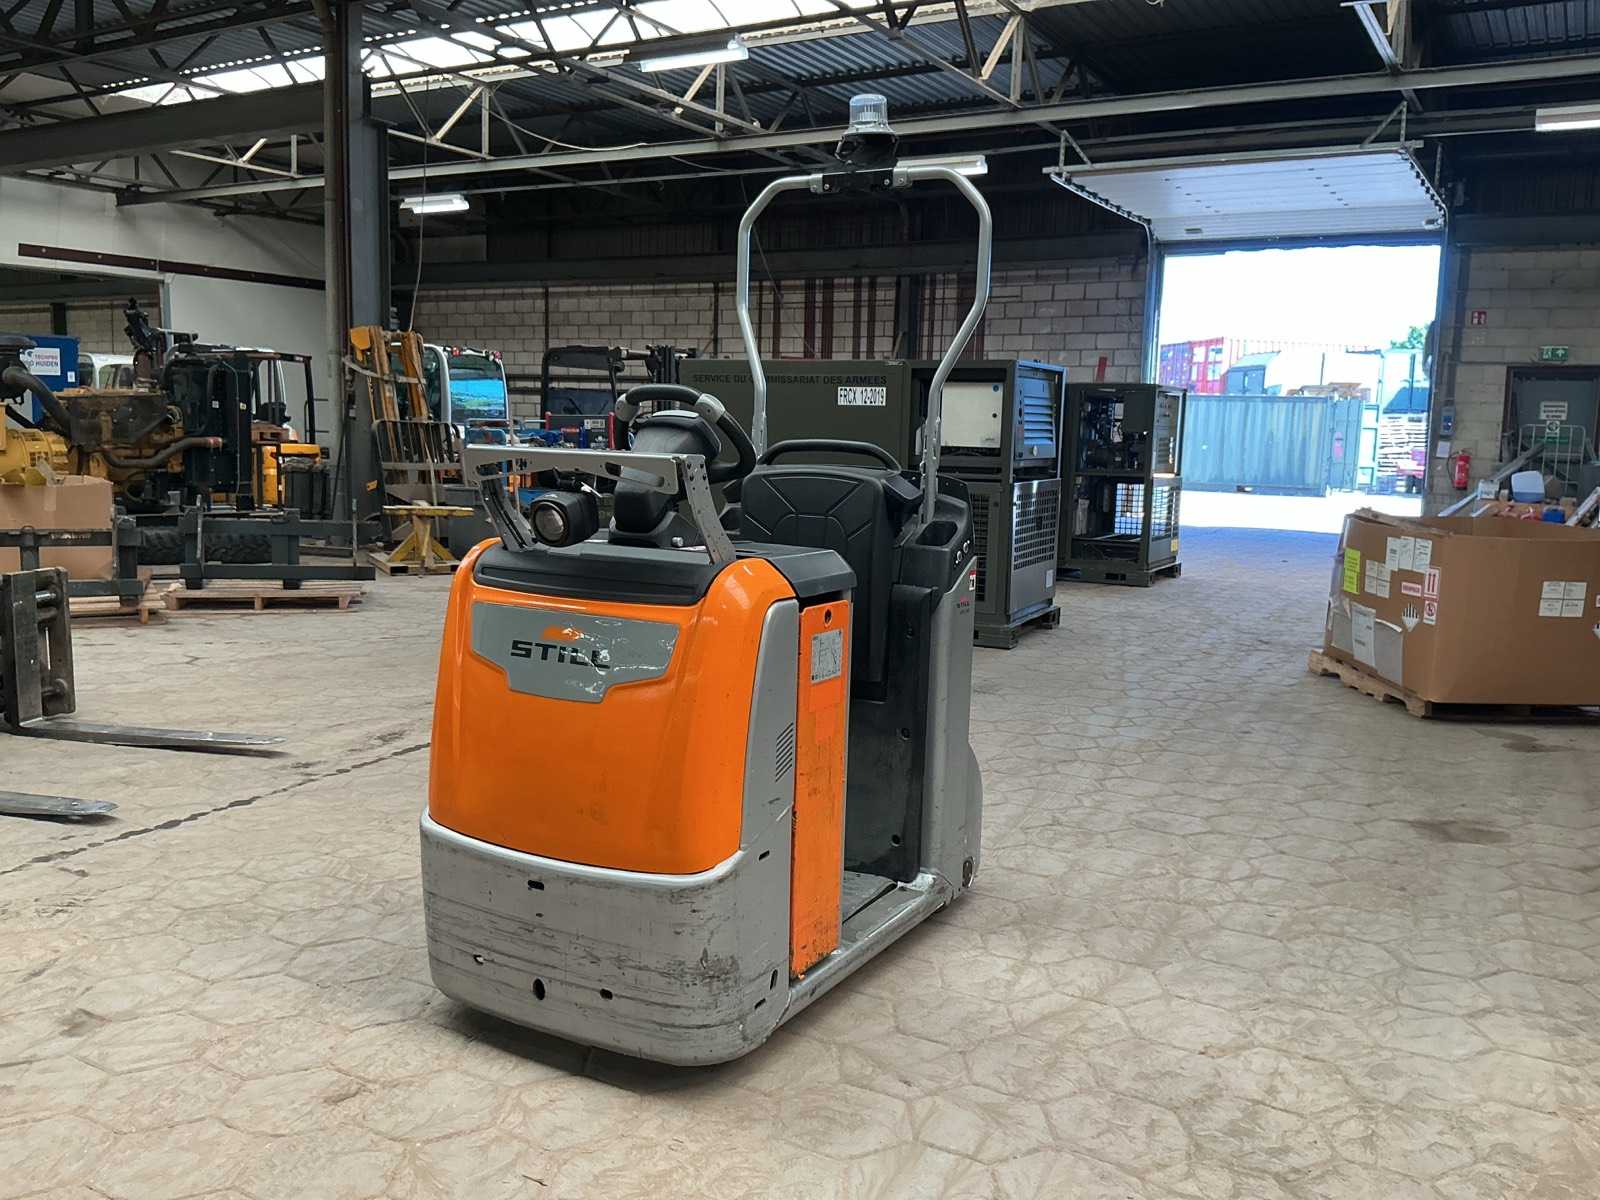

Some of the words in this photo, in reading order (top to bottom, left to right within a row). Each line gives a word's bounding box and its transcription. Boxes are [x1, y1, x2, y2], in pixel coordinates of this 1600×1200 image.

[693, 374, 731, 383] SERVICE
[733, 374, 746, 384] DU
[823, 375, 843, 385] DES
[510, 640, 611, 670] STILL
